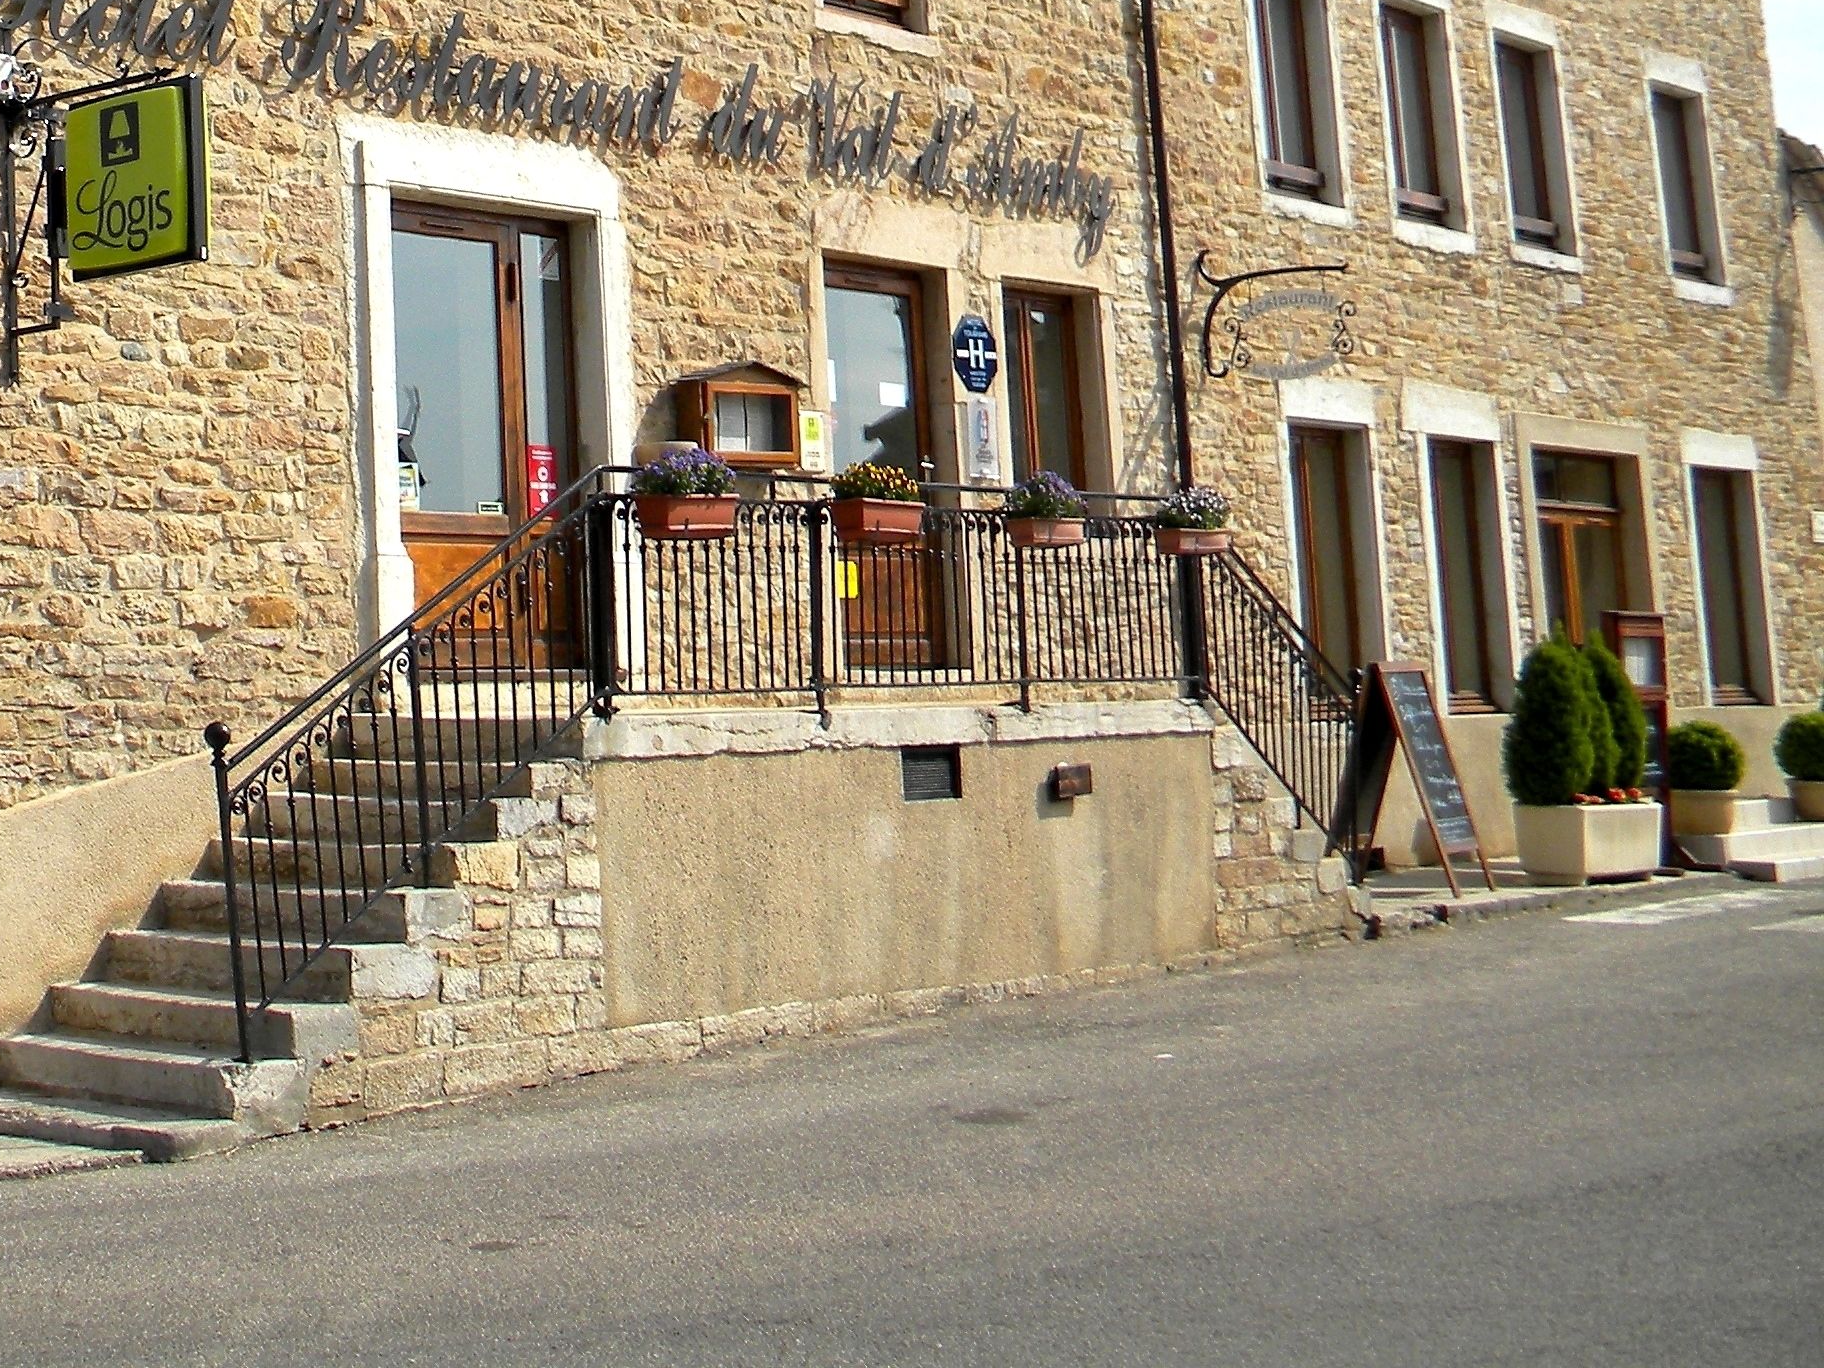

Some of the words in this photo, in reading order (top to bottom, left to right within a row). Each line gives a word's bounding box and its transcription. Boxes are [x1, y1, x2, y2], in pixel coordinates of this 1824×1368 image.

[713, 62, 787, 162] du
[808, 73, 906, 179] Val
[72, 170, 172, 251] Logis
[1242, 292, 1334, 318] Restaurant
[968, 338, 986, 370] H
